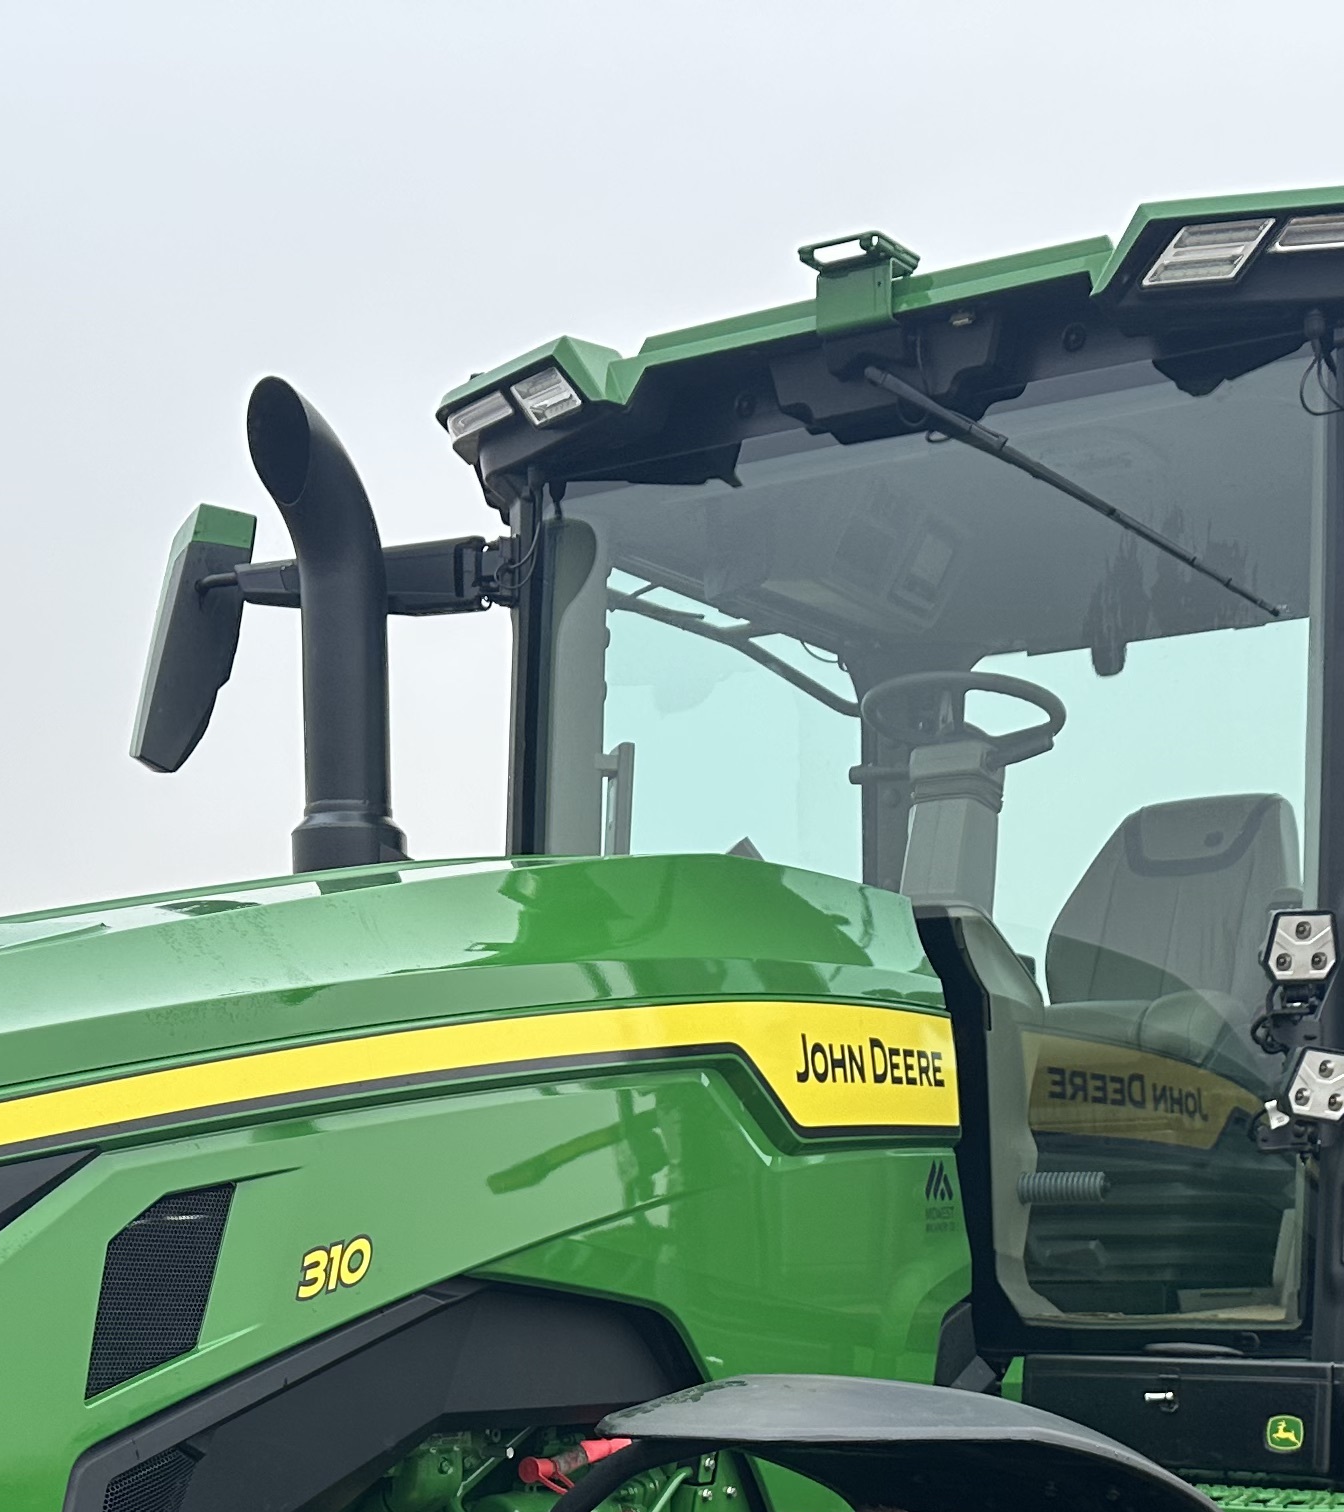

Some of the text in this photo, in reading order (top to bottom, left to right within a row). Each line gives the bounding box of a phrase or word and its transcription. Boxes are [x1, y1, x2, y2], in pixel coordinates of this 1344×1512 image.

[796, 1033, 945, 1087] JOHN DEERE
[296, 1233, 373, 1301] 310
